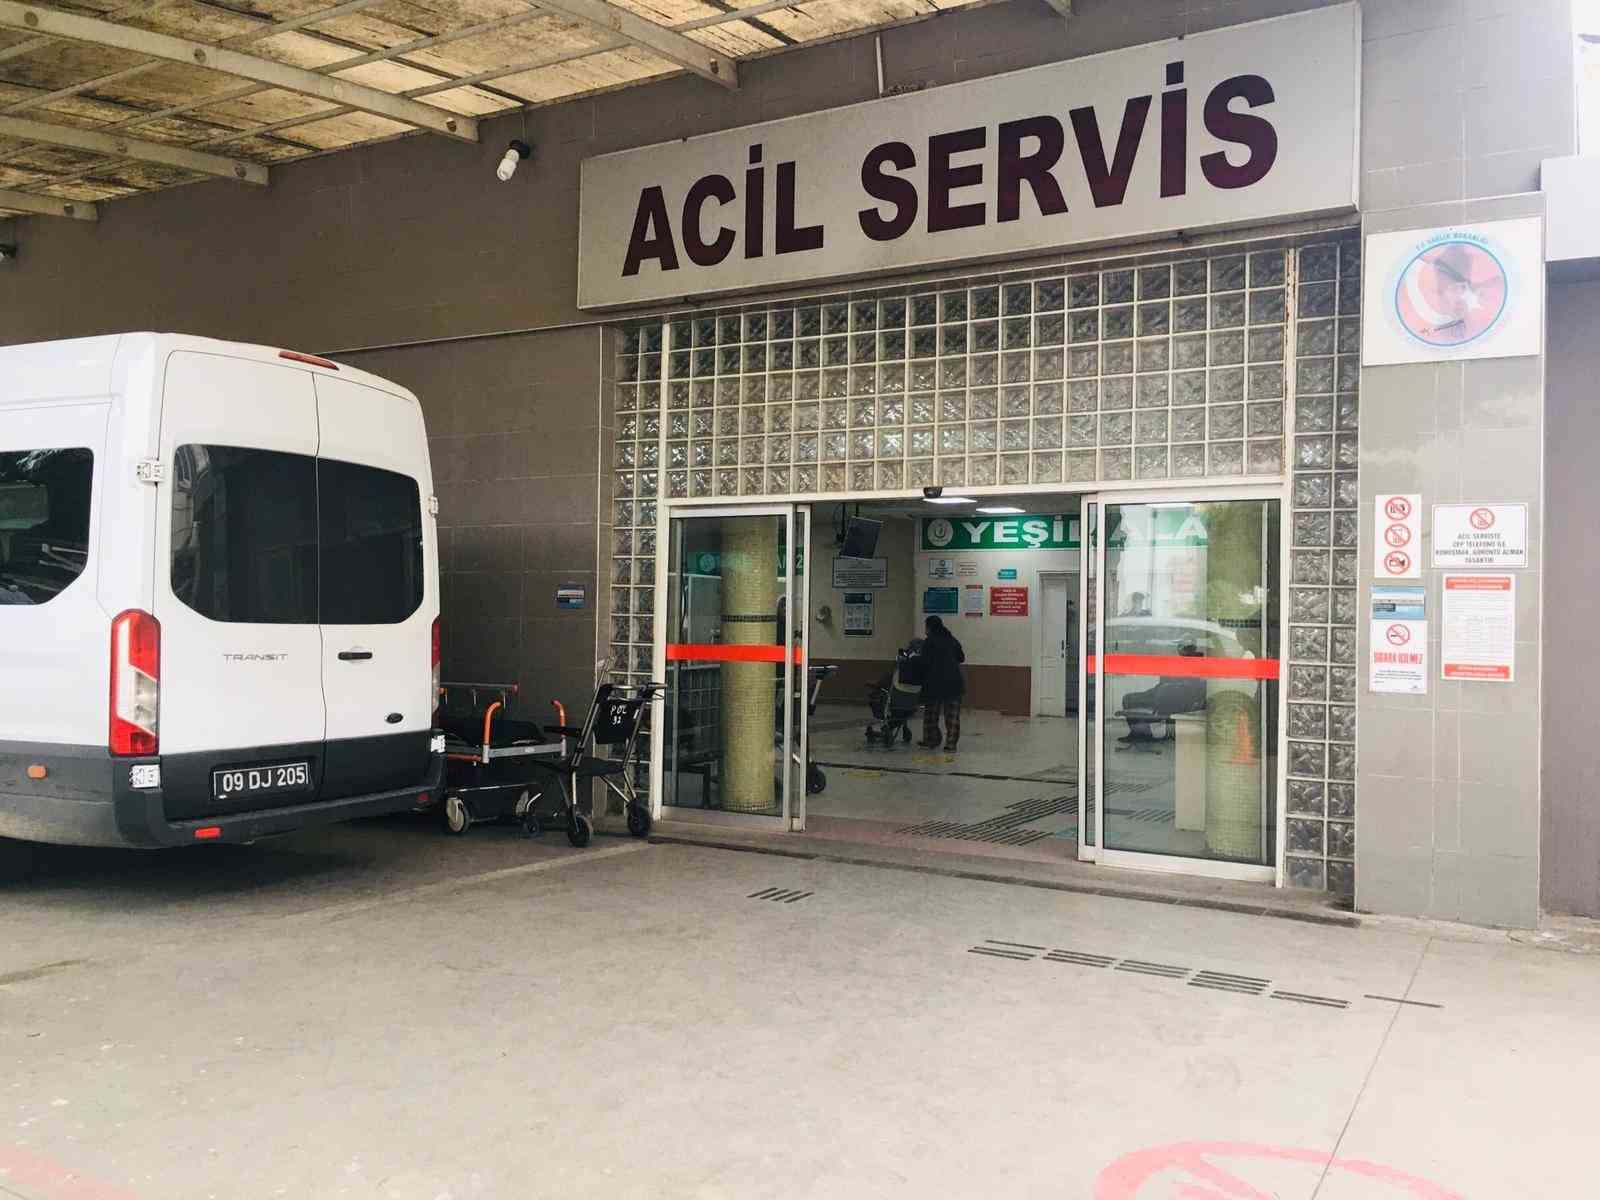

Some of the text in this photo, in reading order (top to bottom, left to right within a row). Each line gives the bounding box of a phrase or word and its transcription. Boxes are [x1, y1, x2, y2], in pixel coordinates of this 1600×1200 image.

[622, 61, 1278, 277] ACİL SERVİS
[223, 653, 289, 661] TRANSIT
[223, 766, 306, 792] 09 DJ 205
